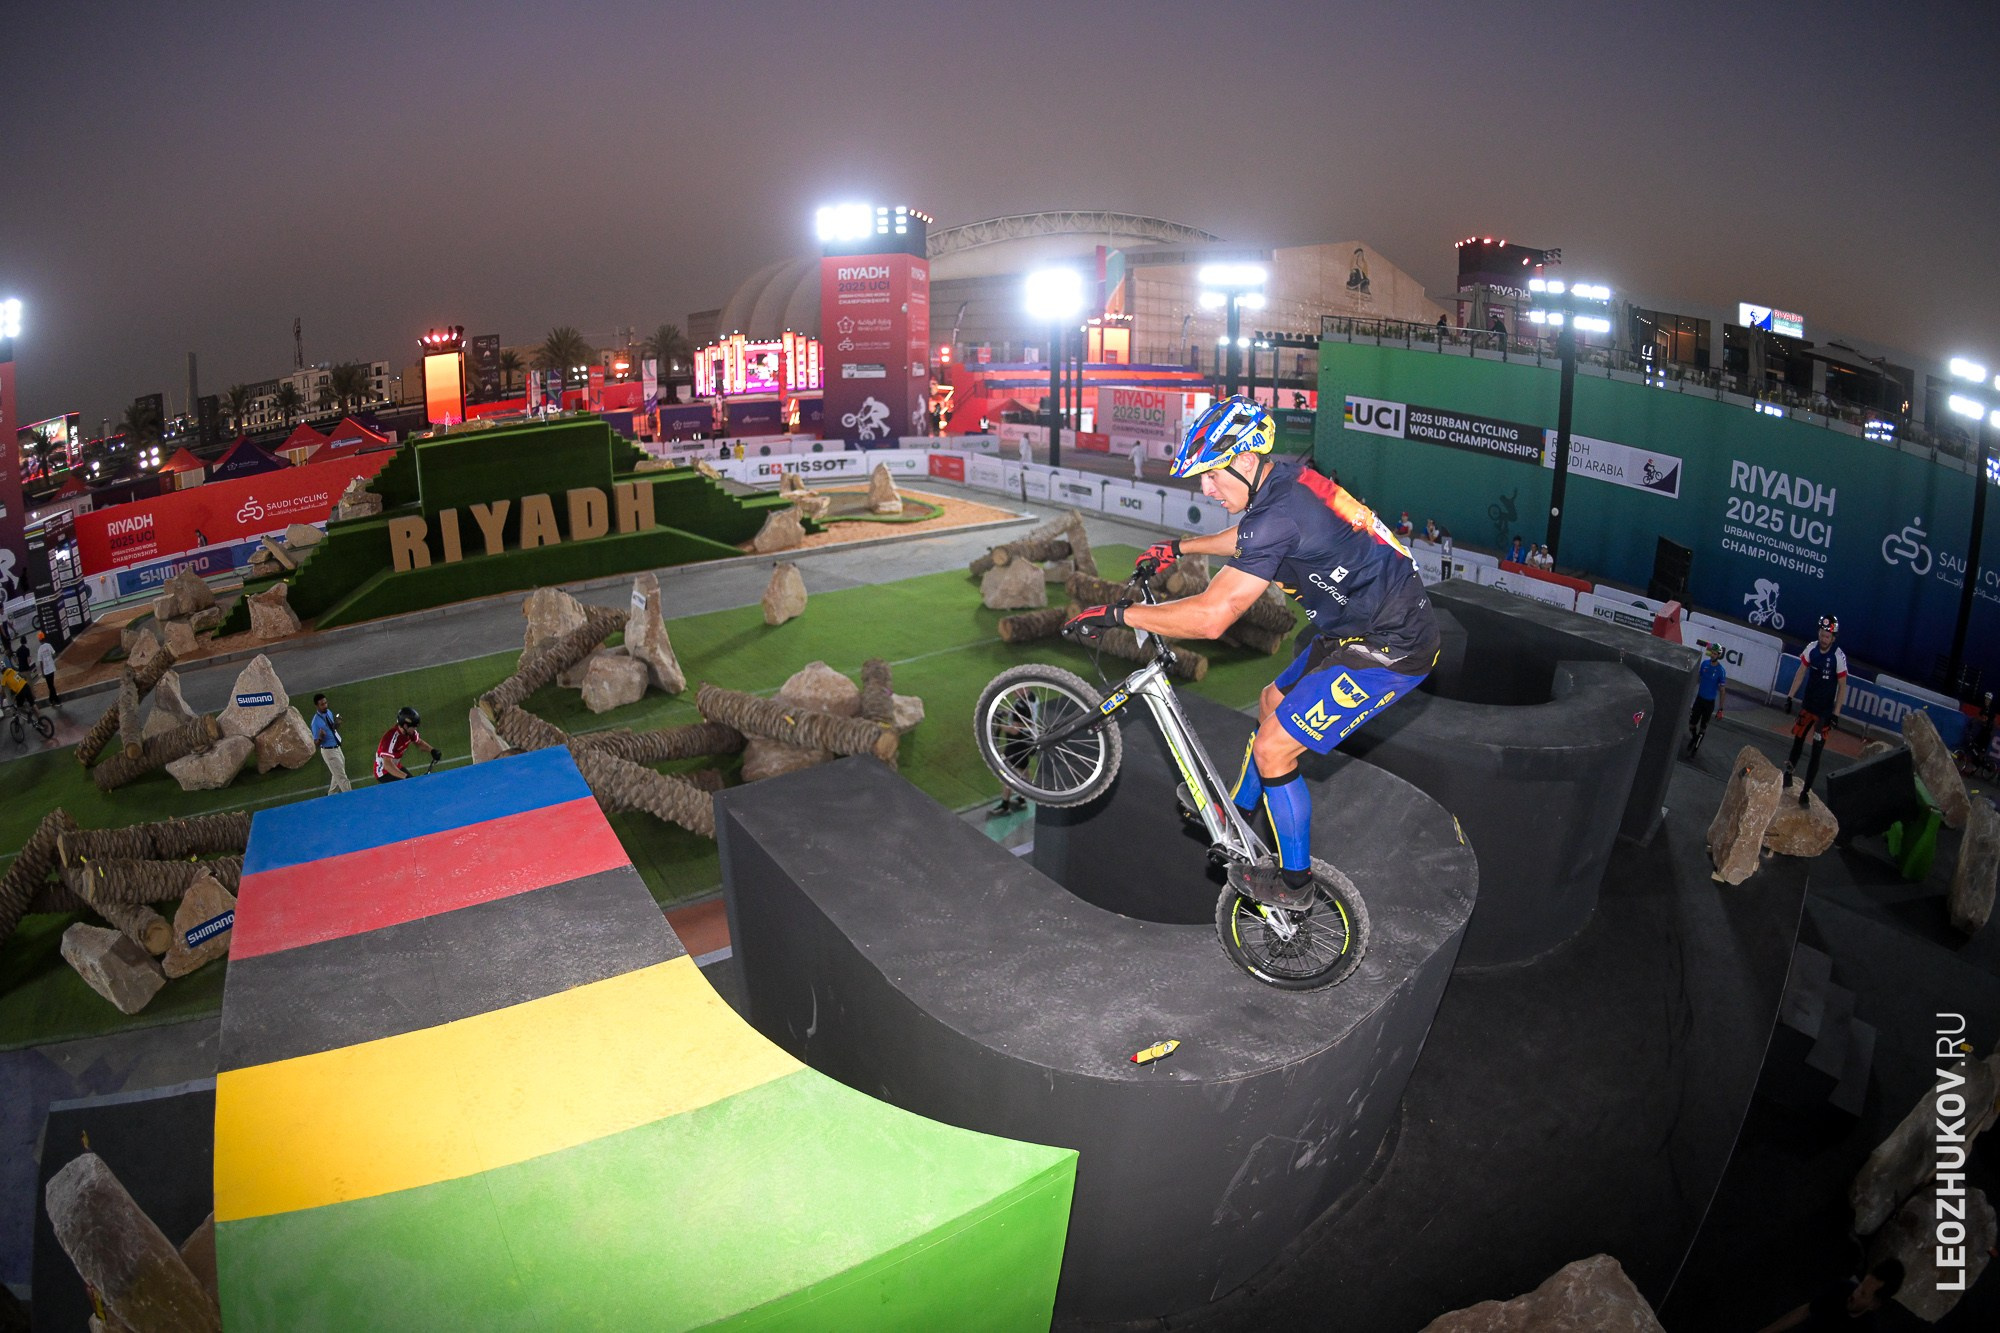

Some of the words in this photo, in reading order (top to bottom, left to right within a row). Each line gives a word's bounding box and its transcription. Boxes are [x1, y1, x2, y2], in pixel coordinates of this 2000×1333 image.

[838, 266, 890, 280] RIYADH
[838, 282, 866, 292] 2025
[869, 281, 890, 290] UCI
[1113, 390, 1166, 409] RIYADH
[1113, 405, 1141, 419] 2025
[1143, 409, 1166, 422] UCI
[1354, 403, 1400, 431] UCI
[1410, 411, 1433, 424] 2025
[1434, 415, 1470, 431] URBAN
[1472, 422, 1519, 440] CYCLING
[1409, 424, 1447, 440] WORLD
[1448, 431, 1539, 459] CHAMPIONSHIPS
[1585, 461, 1624, 478] ARABIA
[1730, 459, 1837, 517] RIYADH
[266, 498, 292, 511] SAUDI
[293, 492, 329, 506] CYCLING
[1124, 496, 1142, 510] UCI
[107, 513, 154, 537] RIYADH
[388, 480, 656, 573] RIYADH
[1725, 496, 1785, 533] 2025
[1789, 514, 1833, 548] UCI
[110, 535, 135, 549] 2025
[136, 530, 155, 543] UCI
[1443, 540, 1450, 553] 4
[1724, 524, 1756, 541] URBAN
[1756, 534, 1795, 553] CYCLING
[1796, 546, 1828, 563] WORLD
[112, 548, 158, 563] CHAMPIONSHIPS
[1721, 538, 1825, 579] CHAMPIONSHIPS
[1939, 552, 1982, 580] SAUI
[1308, 573, 1350, 606] Cofidis
[1597, 609, 1614, 619] UCI
[237, 695, 273, 704] SHIMANO
[187, 914, 235, 944] SHIMANO
